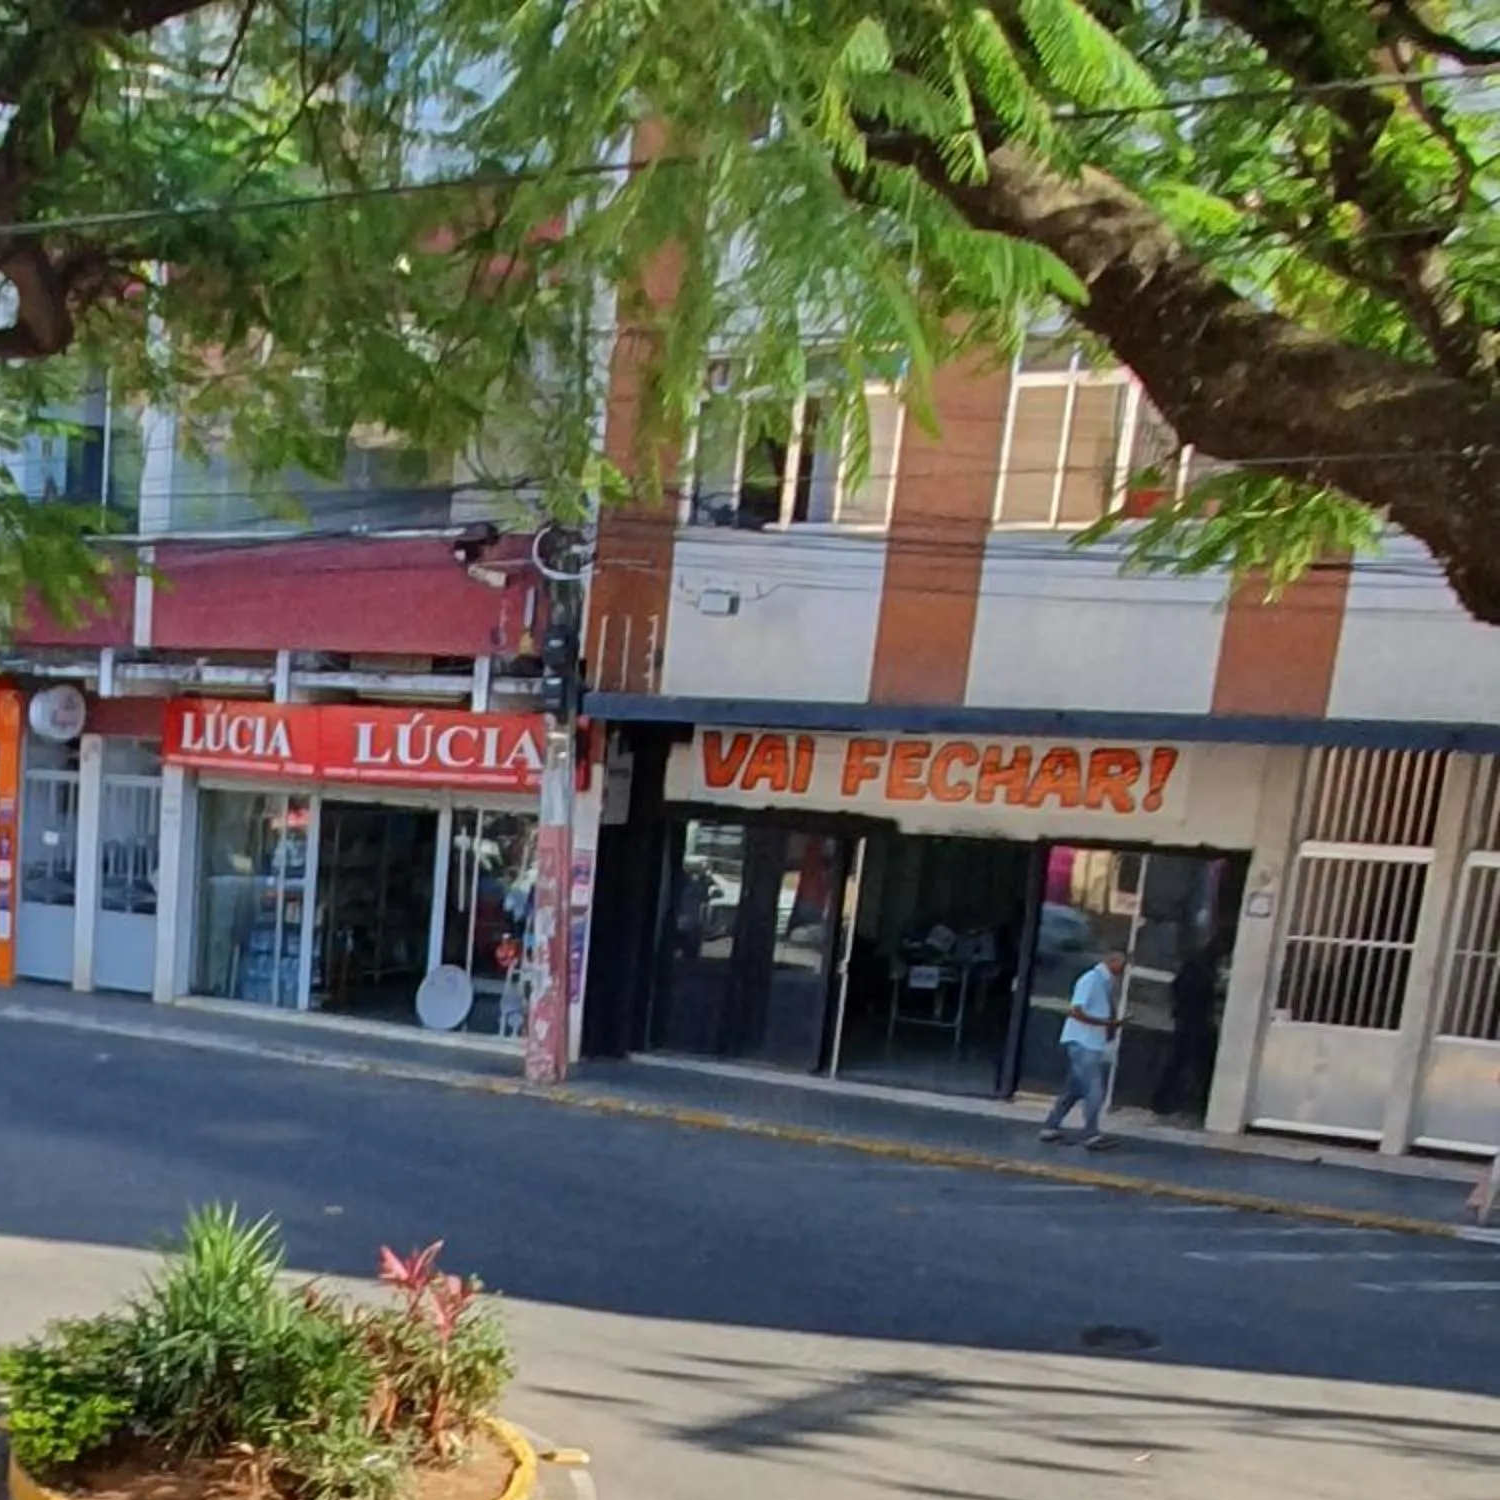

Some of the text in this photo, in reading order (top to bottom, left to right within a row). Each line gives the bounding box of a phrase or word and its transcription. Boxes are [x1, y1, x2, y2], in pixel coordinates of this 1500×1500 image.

[181, 702, 292, 758] LÚCIA
[353, 712, 544, 770] LÚCIA
[702, 731, 1180, 813] VAI FECHAR!
